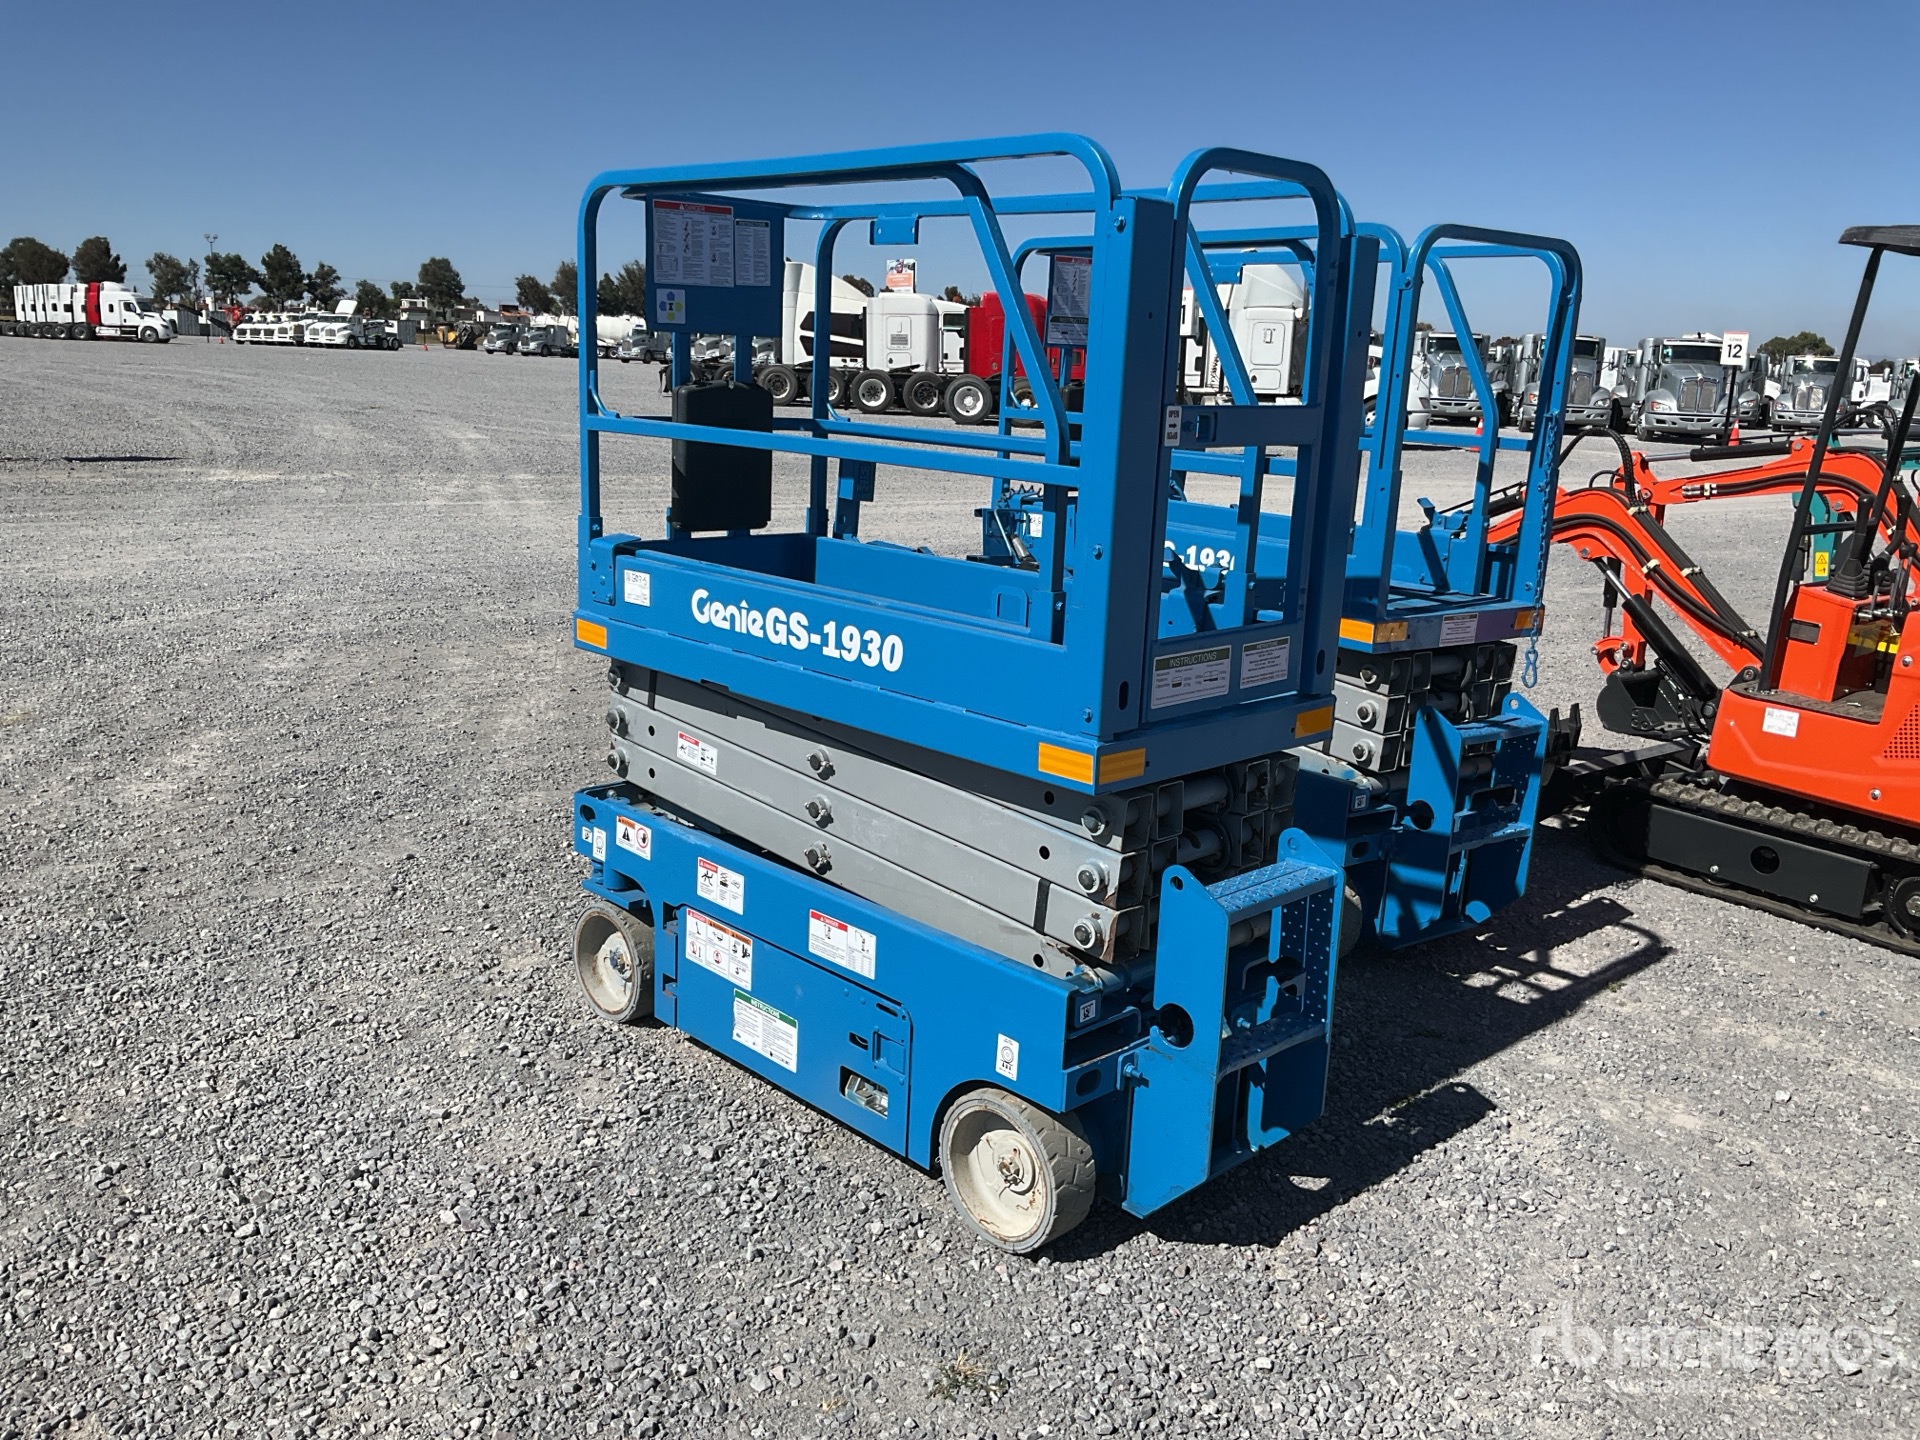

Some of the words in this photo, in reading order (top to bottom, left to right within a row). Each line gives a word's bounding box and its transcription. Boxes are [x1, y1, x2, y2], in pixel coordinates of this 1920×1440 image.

[1727, 343, 1743, 358] 12
[765, 607, 904, 672] GS-1930
[1168, 651, 1217, 668] INSTRUCTIONS
